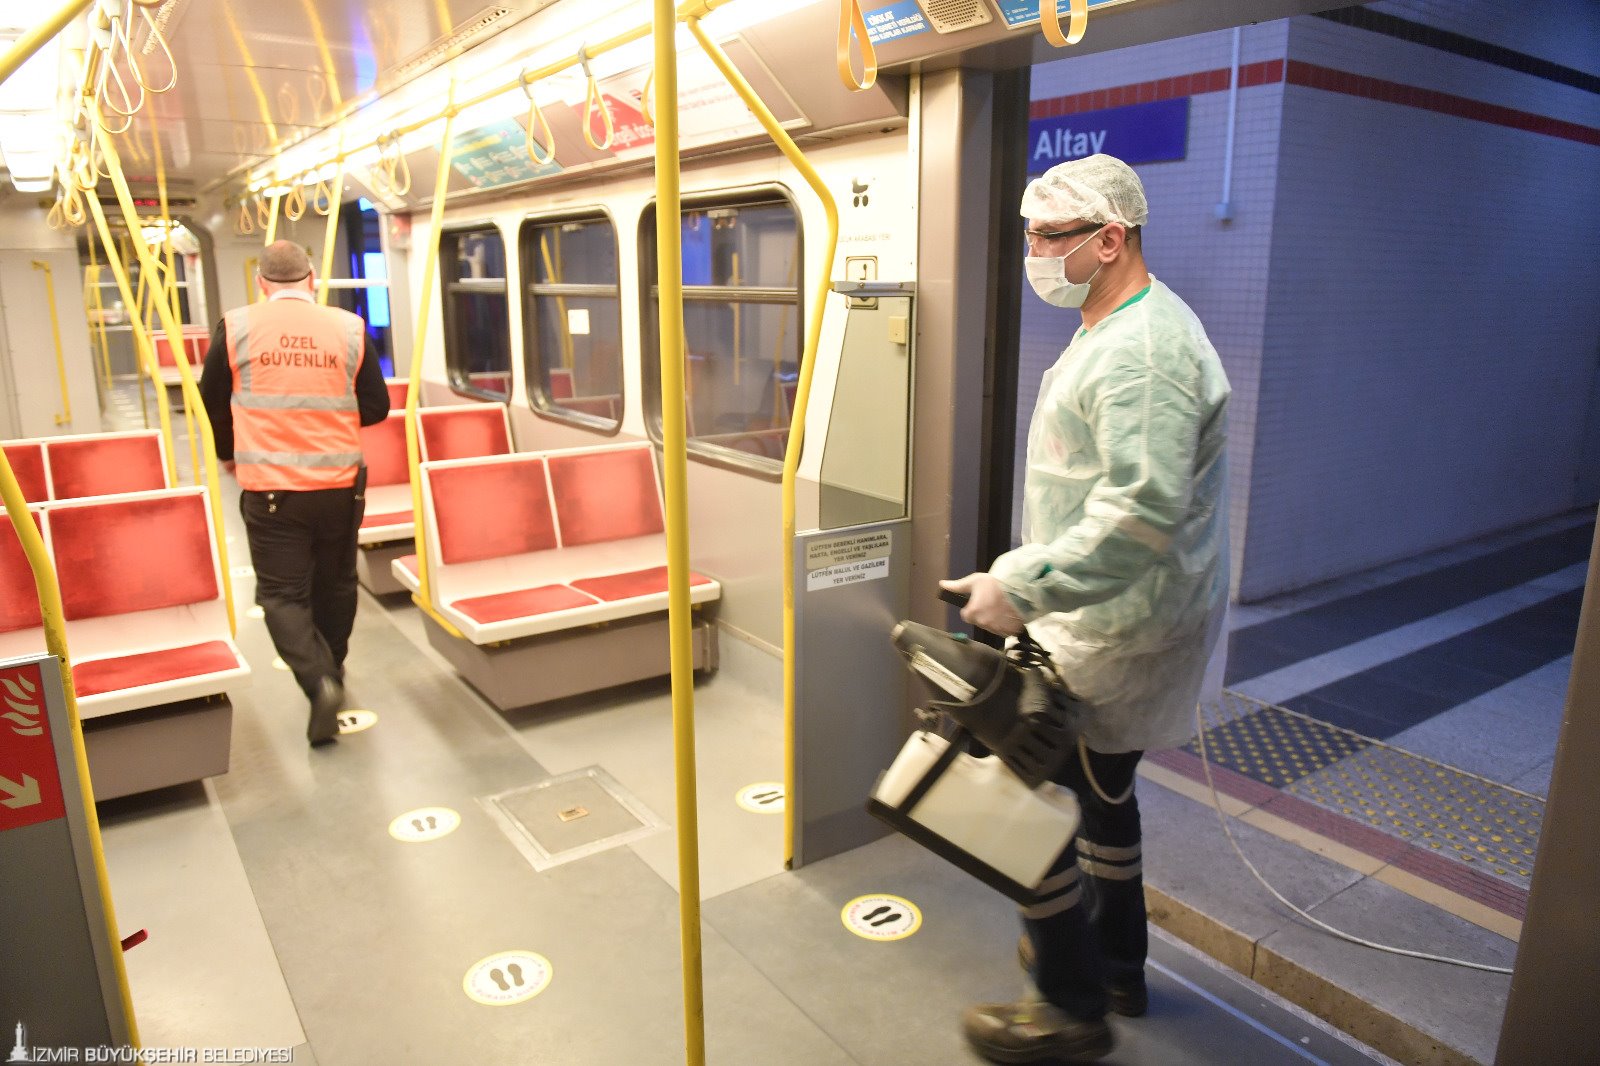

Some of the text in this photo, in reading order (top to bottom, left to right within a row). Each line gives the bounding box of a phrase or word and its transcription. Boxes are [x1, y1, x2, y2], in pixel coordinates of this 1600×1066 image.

[1033, 127, 1107, 160] Altay
[280, 332, 318, 350] ÖZEL
[260, 349, 338, 369] GÜVENLİK
[833, 577, 844, 585] YER
